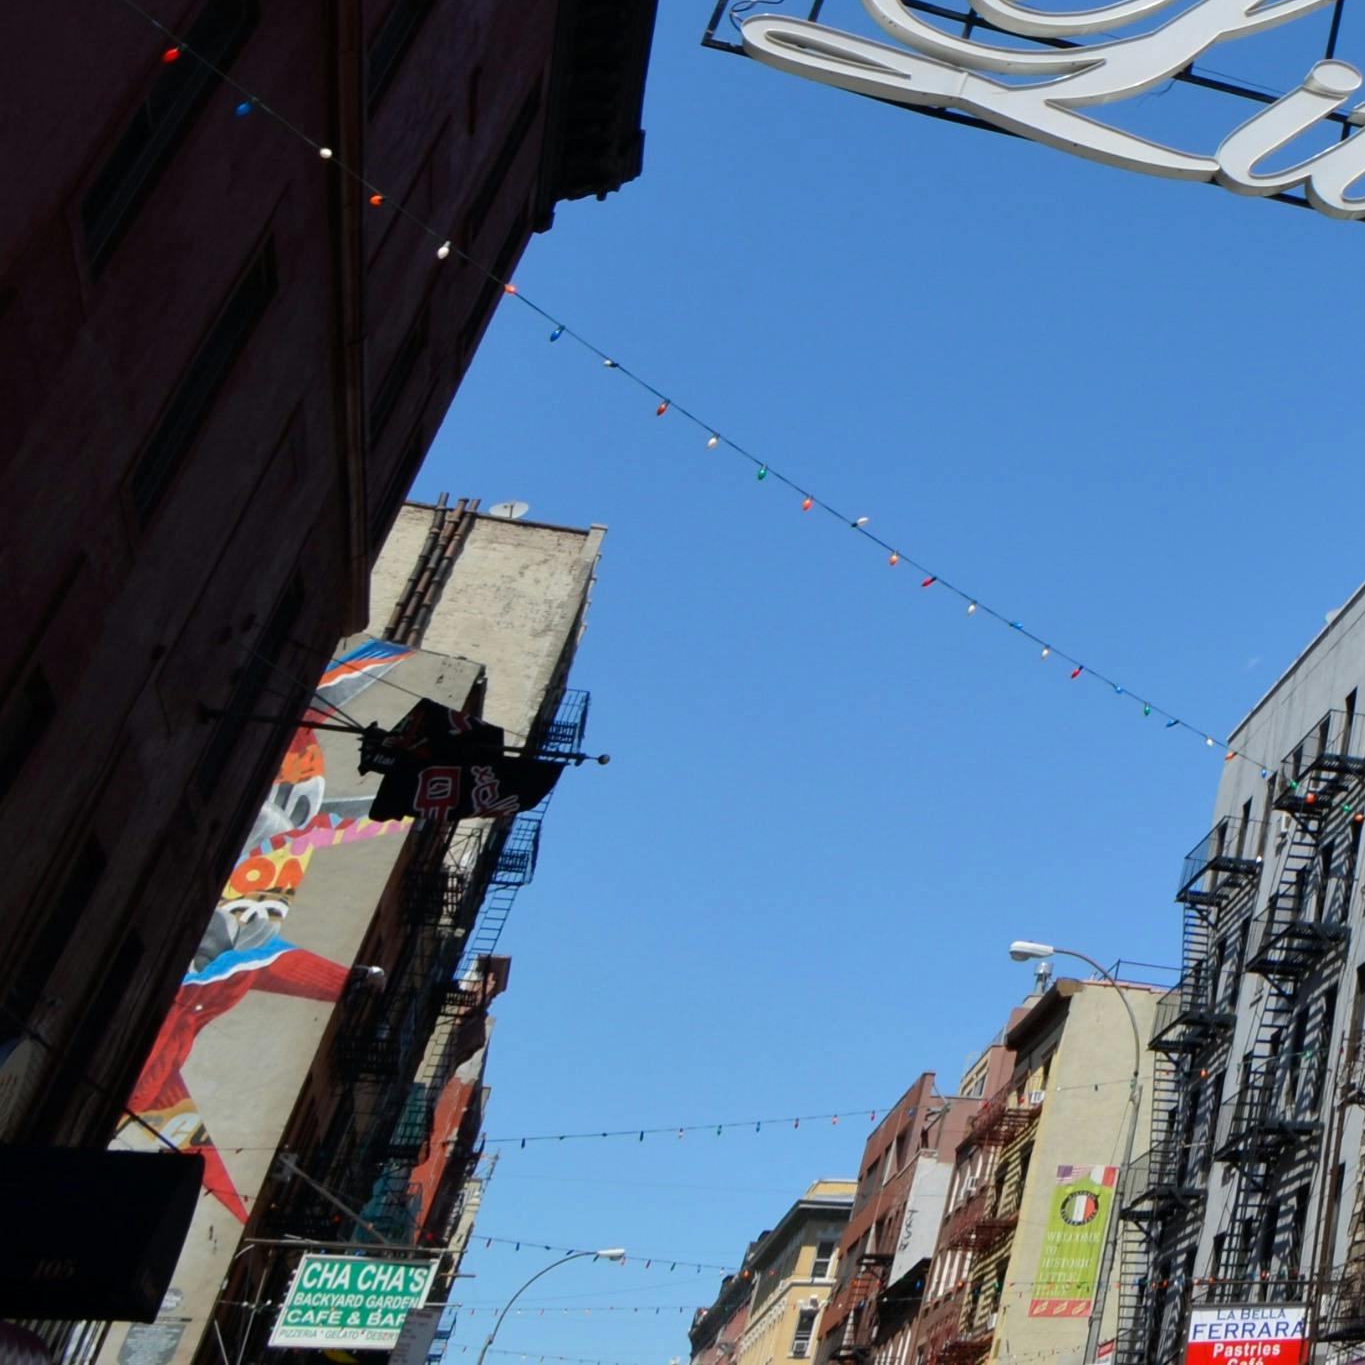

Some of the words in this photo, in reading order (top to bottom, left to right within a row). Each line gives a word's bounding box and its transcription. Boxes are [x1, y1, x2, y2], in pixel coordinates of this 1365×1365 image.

[302, 1261, 351, 1290] CHA
[357, 1263, 428, 1293] CHA'S
[293, 1291, 364, 1308] BACKYARD
[347, 1310, 360, 1325] &
[1217, 1309, 1236, 1321] LA
[1240, 1308, 1286, 1320] BELLA
[1192, 1321, 1304, 1341] FERRARA
[1213, 1343, 1281, 1358] Pastries
